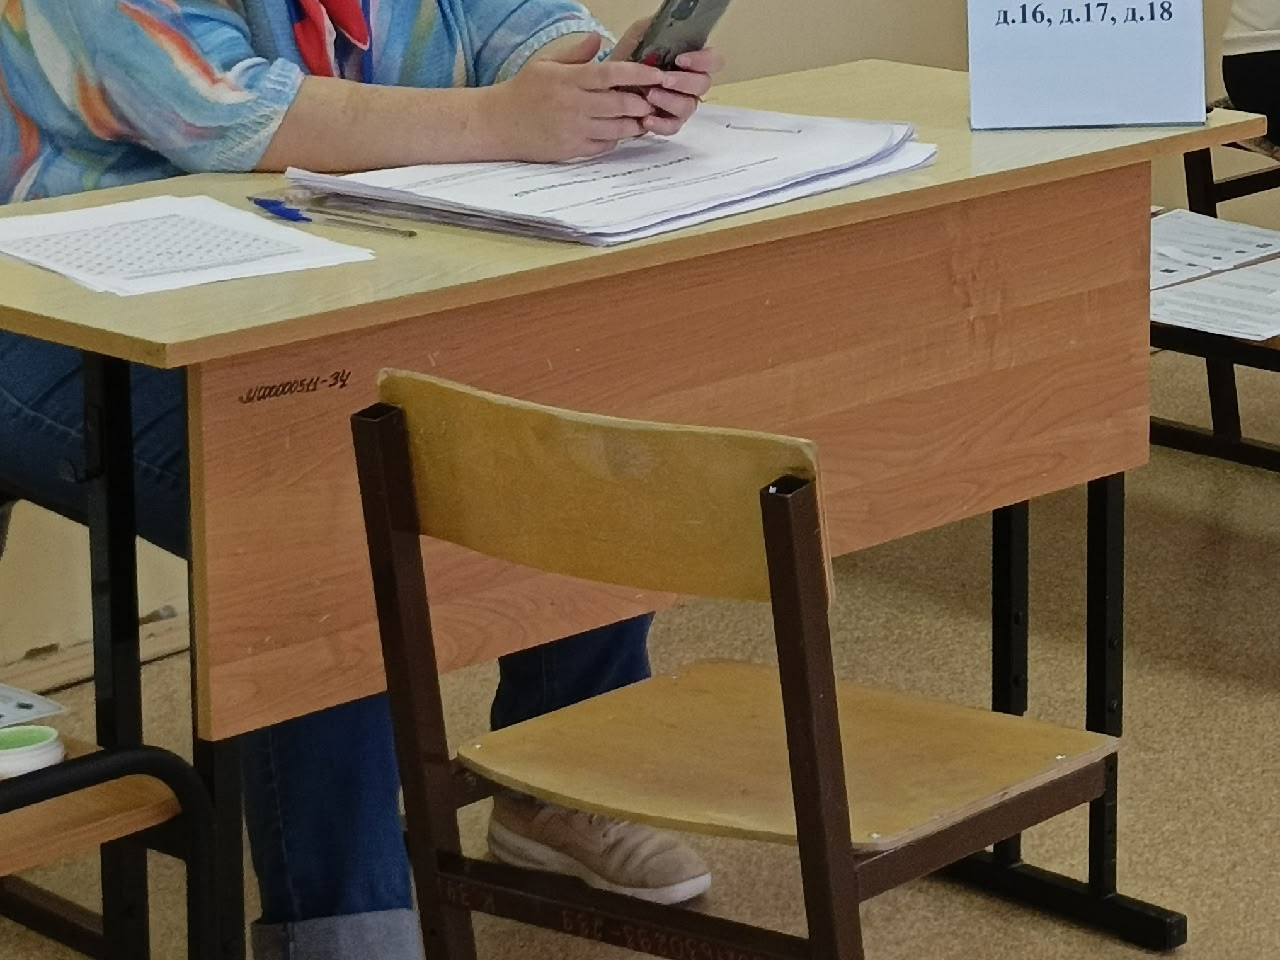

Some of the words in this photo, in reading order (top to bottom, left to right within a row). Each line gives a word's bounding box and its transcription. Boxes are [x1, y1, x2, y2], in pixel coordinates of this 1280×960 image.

[994, 2, 1053, 27] д.16,
[1059, 2, 1118, 26] д.17,
[1124, 0, 1174, 24] д.18
